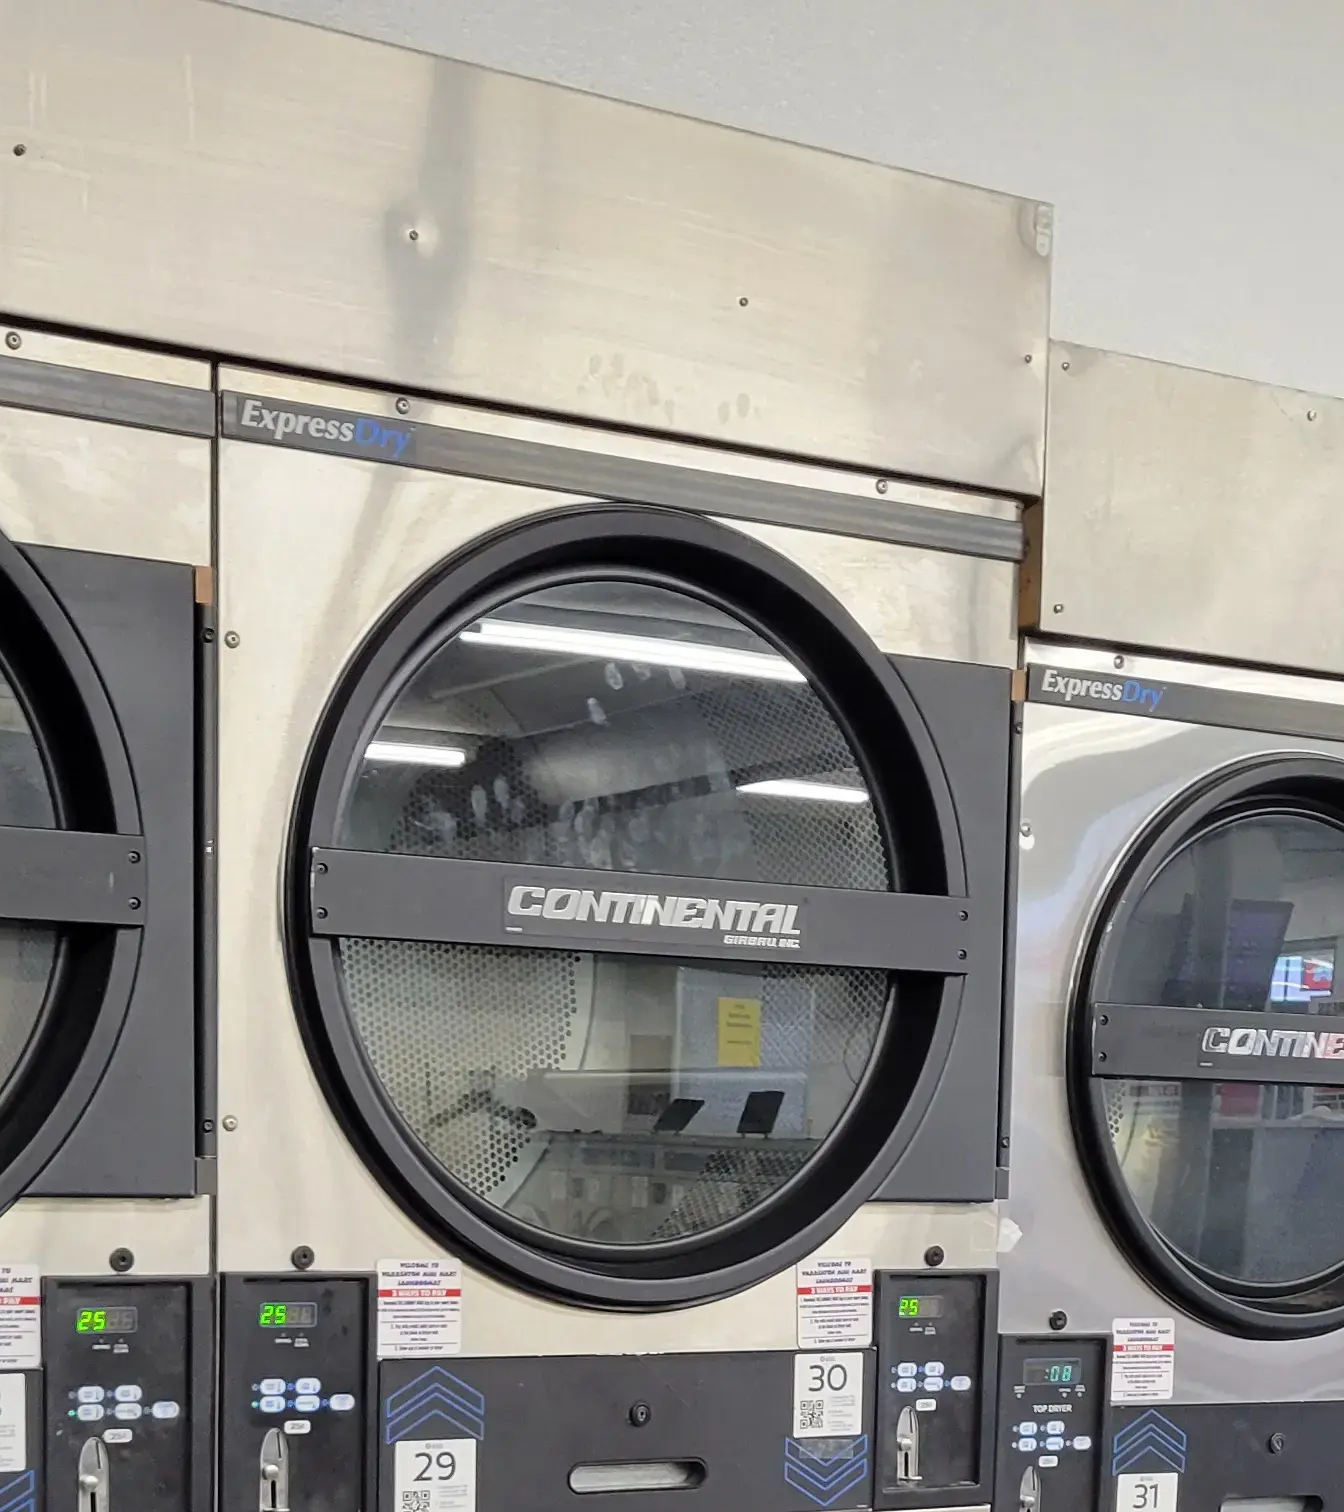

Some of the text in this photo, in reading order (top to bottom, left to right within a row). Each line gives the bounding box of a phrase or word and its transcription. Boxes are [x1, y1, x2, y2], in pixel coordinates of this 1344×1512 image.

[240, 399, 412, 458] ExpressDry
[1041, 669, 1164, 712] ExpressDry
[507, 885, 801, 935] CONTINENTAL
[77, 1310, 106, 1331] 25
[260, 1305, 286, 1324] 25
[899, 1299, 918, 1316] 25
[808, 1364, 847, 1392] 30
[1032, 1404, 1072, 1413] TOP DRYER
[413, 1451, 456, 1481] 29
[1132, 1483, 1159, 1509] 31
